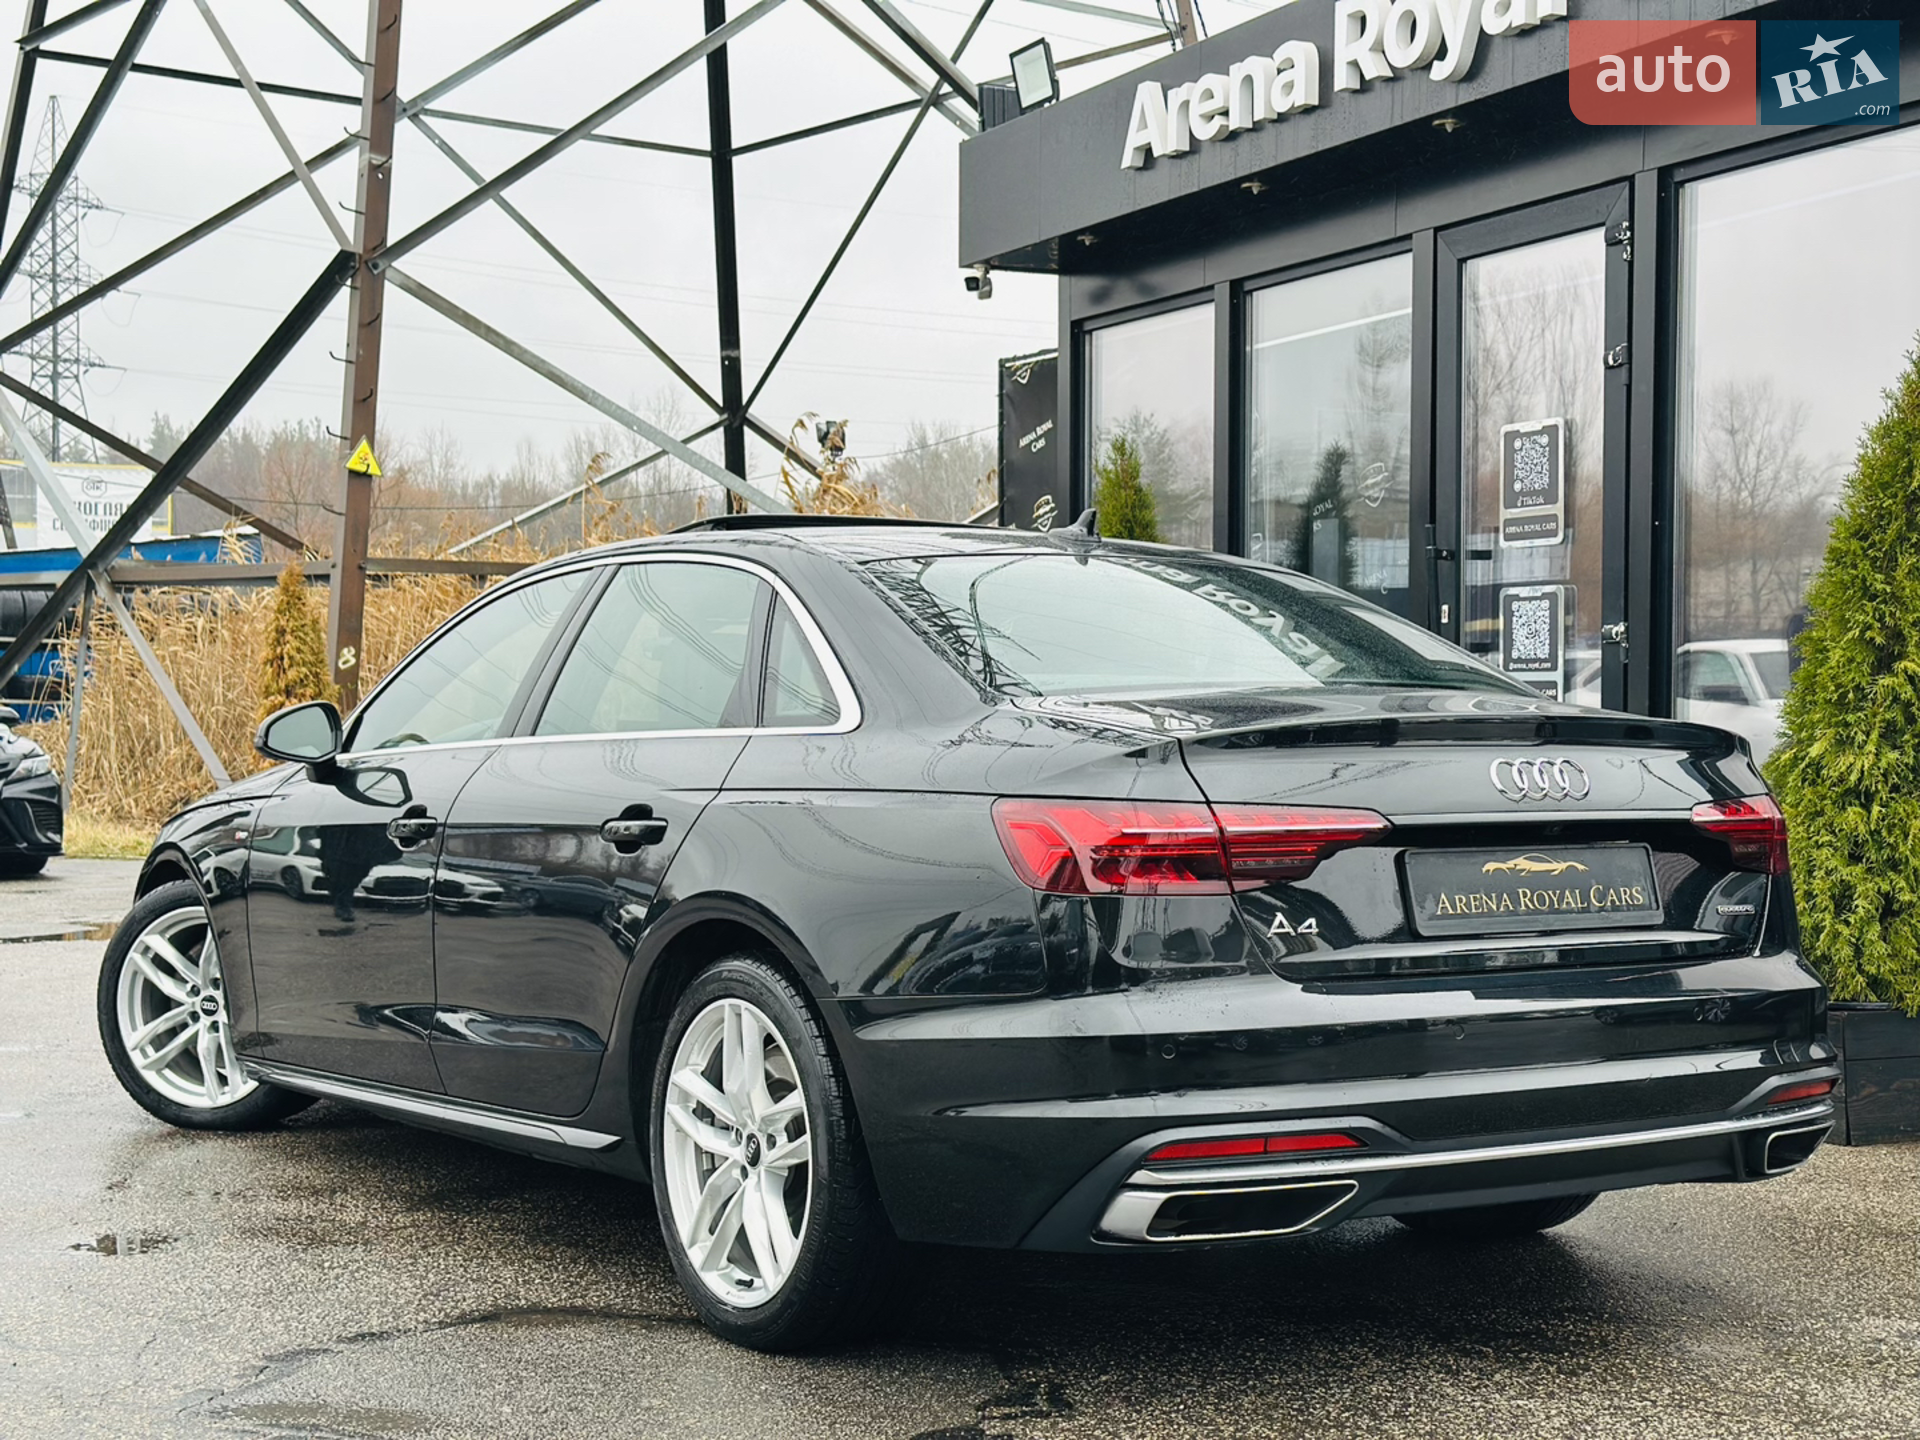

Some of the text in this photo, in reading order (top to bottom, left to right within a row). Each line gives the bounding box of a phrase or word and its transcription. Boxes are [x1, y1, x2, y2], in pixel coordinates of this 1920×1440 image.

[1120, 0, 1568, 170] Arena Roya
[1522, 494, 1545, 506] TikTok
[1436, 884, 1644, 915] ARENA ROYAL CARS
[1267, 912, 1319, 938] A4
